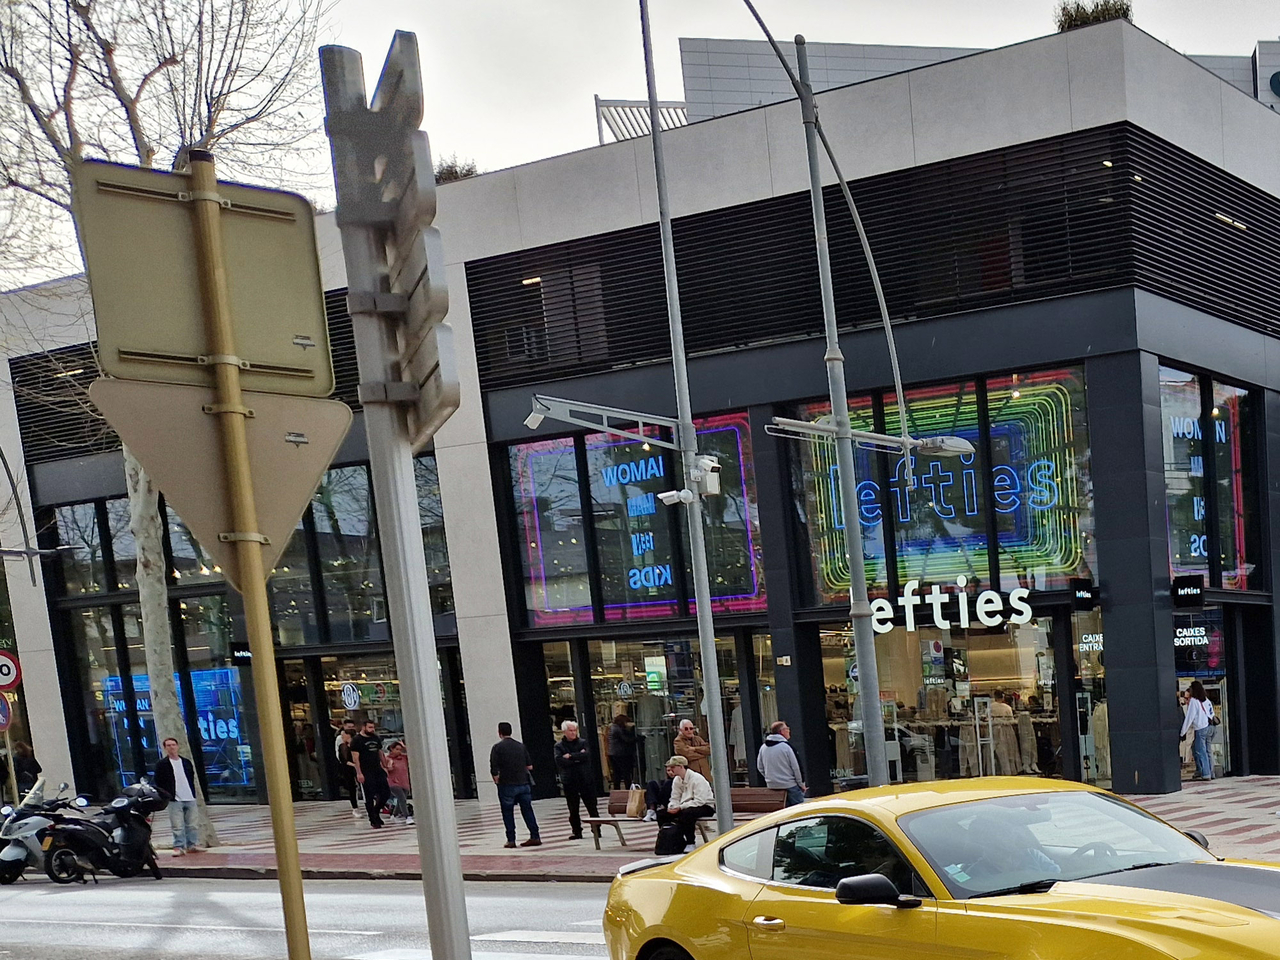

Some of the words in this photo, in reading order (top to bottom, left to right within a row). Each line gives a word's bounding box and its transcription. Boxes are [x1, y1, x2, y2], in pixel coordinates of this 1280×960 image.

[1178, 587, 1201, 596] lefties
[849, 575, 1033, 633] efties
[1176, 627, 1206, 637] CAIXES
[1082, 633, 1104, 643] CAIXE
[1173, 636, 1209, 647] SORTIDA
[1079, 643, 1104, 652] ENTRA
[0, 663, 11, 677] 0
[198, 711, 239, 740] ties
